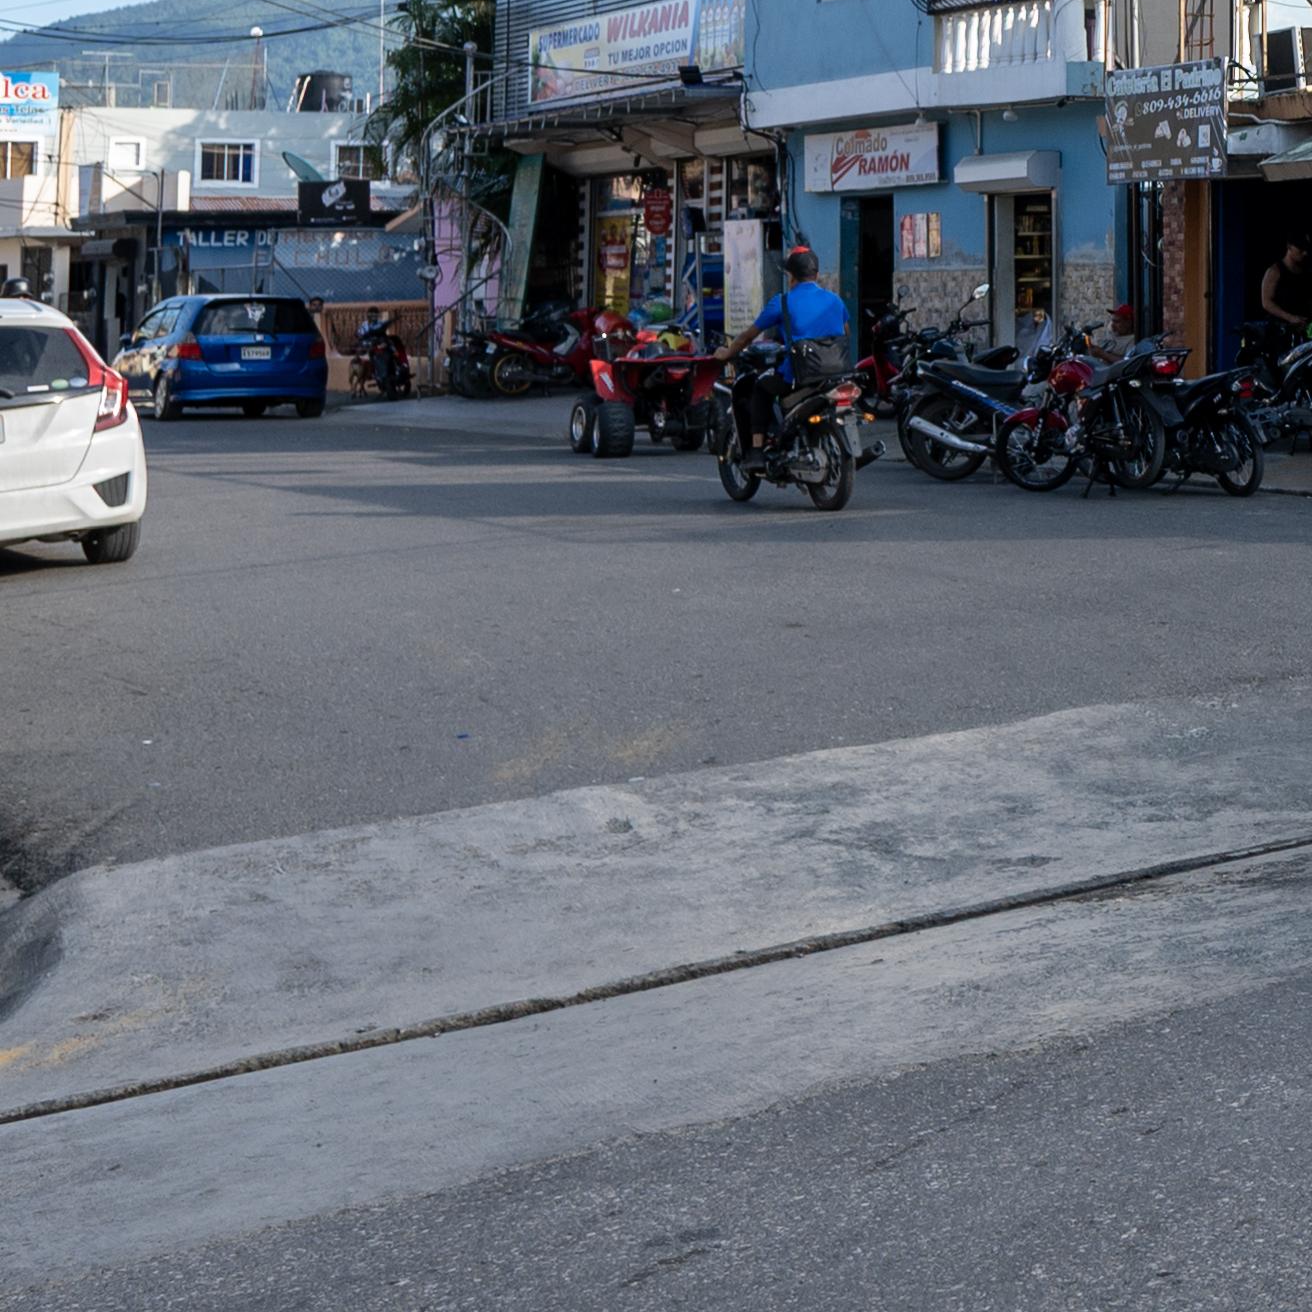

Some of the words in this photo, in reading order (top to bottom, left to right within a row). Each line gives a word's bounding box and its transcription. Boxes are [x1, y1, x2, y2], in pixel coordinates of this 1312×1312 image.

[539, 23, 599, 52] SUPERMERCADO
[607, 0, 689, 43] WILKANIA
[608, 53, 619, 66] TU
[621, 46, 651, 63] MEJOR
[1143, 87, 1221, 115] 809-434-6616
[836, 134, 888, 155] Colmado
[858, 149, 911, 175] RAMÓN
[177, 229, 248, 248] TALLER
